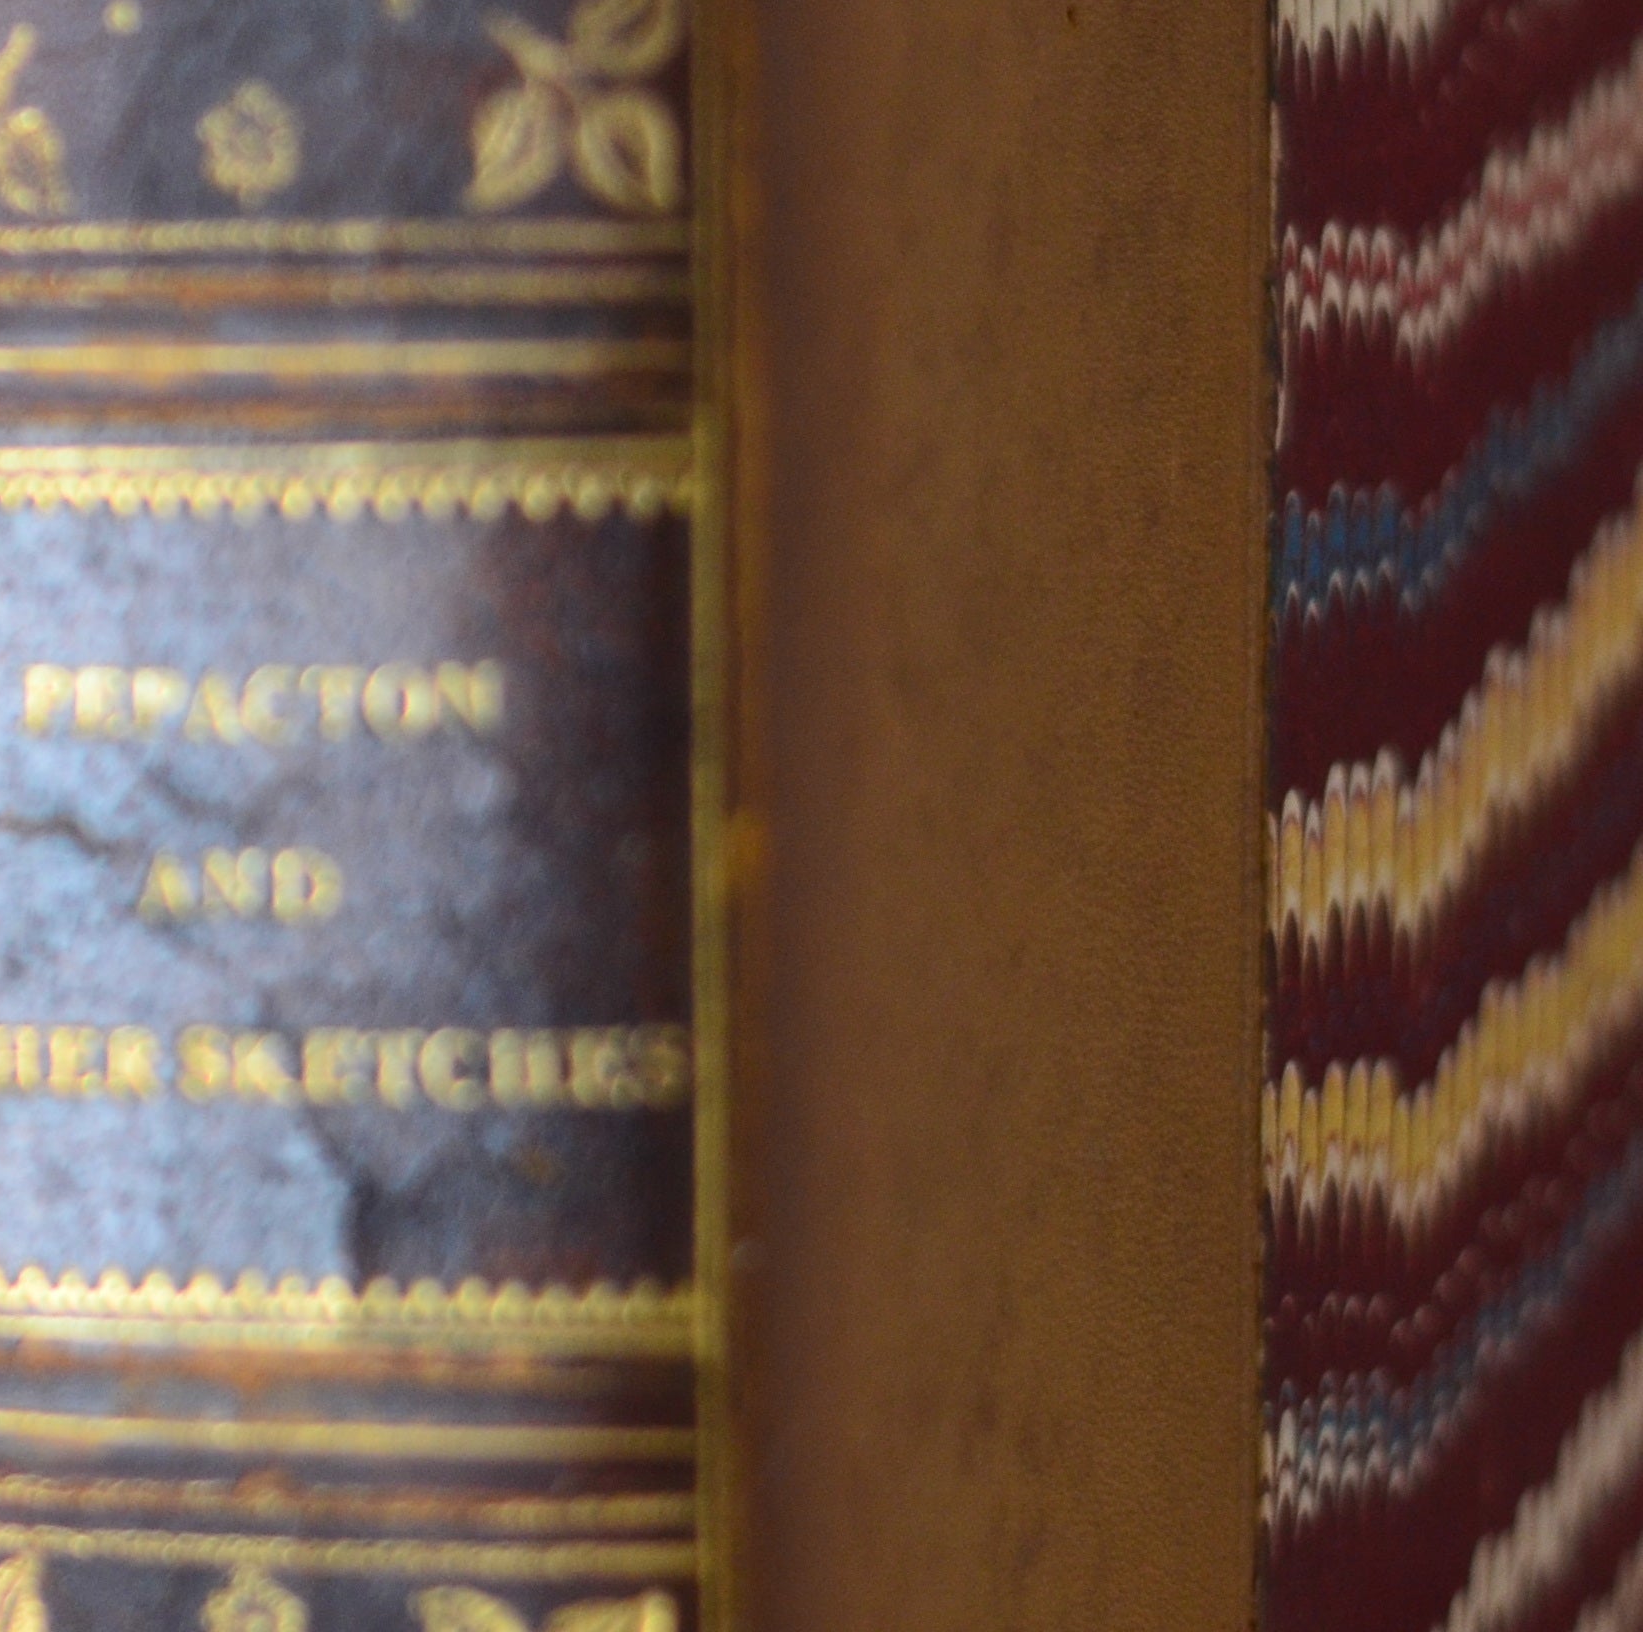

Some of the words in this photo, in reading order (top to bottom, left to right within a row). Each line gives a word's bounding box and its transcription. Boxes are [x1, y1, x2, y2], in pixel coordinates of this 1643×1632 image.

[18, 658, 509, 748] PEPACTON
[135, 845, 347, 928] AND
[174, 1022, 695, 1114] SKETCHES
